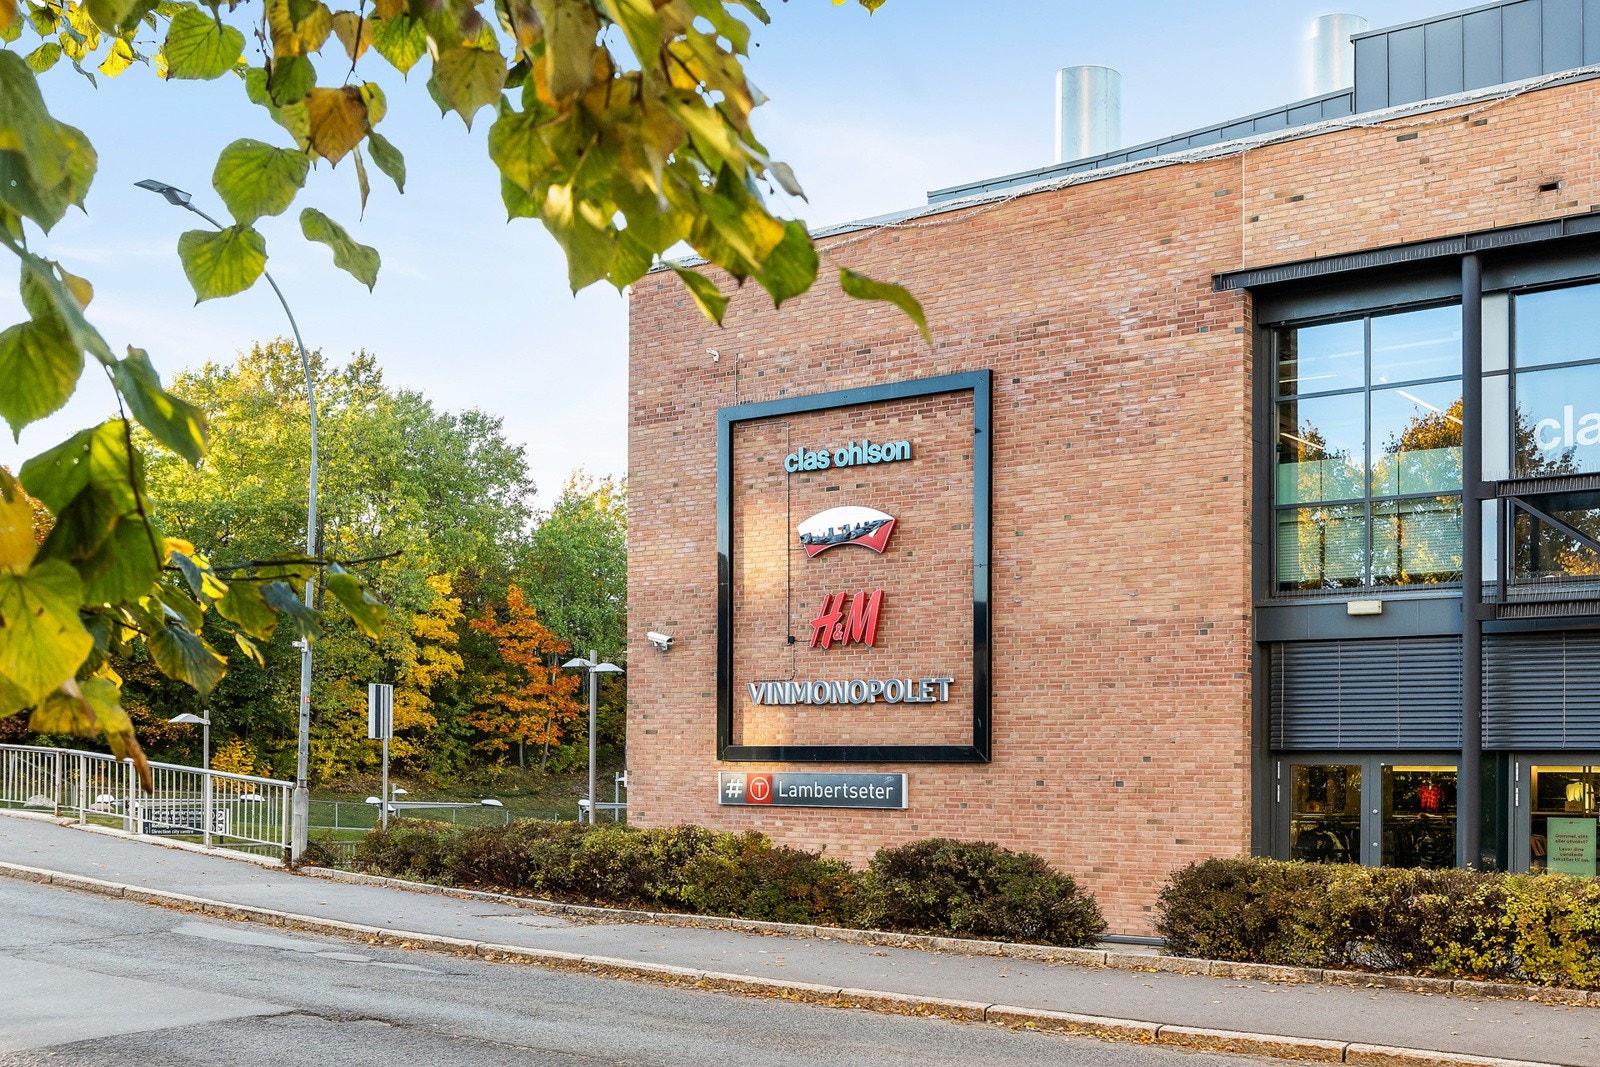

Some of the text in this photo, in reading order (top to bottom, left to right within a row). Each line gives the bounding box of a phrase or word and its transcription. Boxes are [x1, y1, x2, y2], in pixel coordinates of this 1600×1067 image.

[784, 439, 911, 473] clas ohlson
[809, 589, 884, 649] H&M
[747, 678, 955, 705] VINMONOPOLET
[779, 780, 894, 800] Lambertseter
